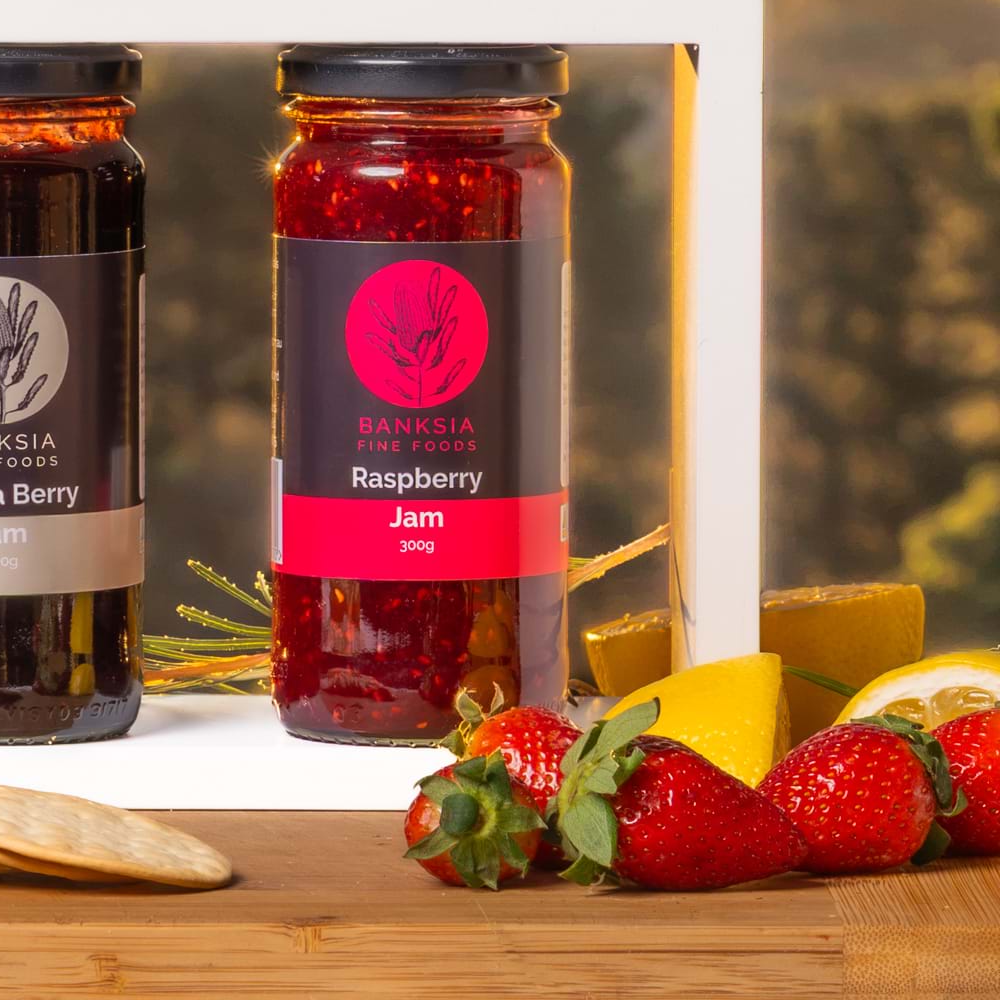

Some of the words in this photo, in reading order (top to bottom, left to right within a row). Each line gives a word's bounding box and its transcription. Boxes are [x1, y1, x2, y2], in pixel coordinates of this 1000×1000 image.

[359, 416, 474, 434] BANKSIA
[357, 439, 401, 451] FINE
[412, 439, 477, 451] FOODS
[352, 466, 483, 494] Raspberry
[12, 483, 79, 508] Berry
[389, 506, 444, 527] Jam
[399, 539, 435, 553] 300g
